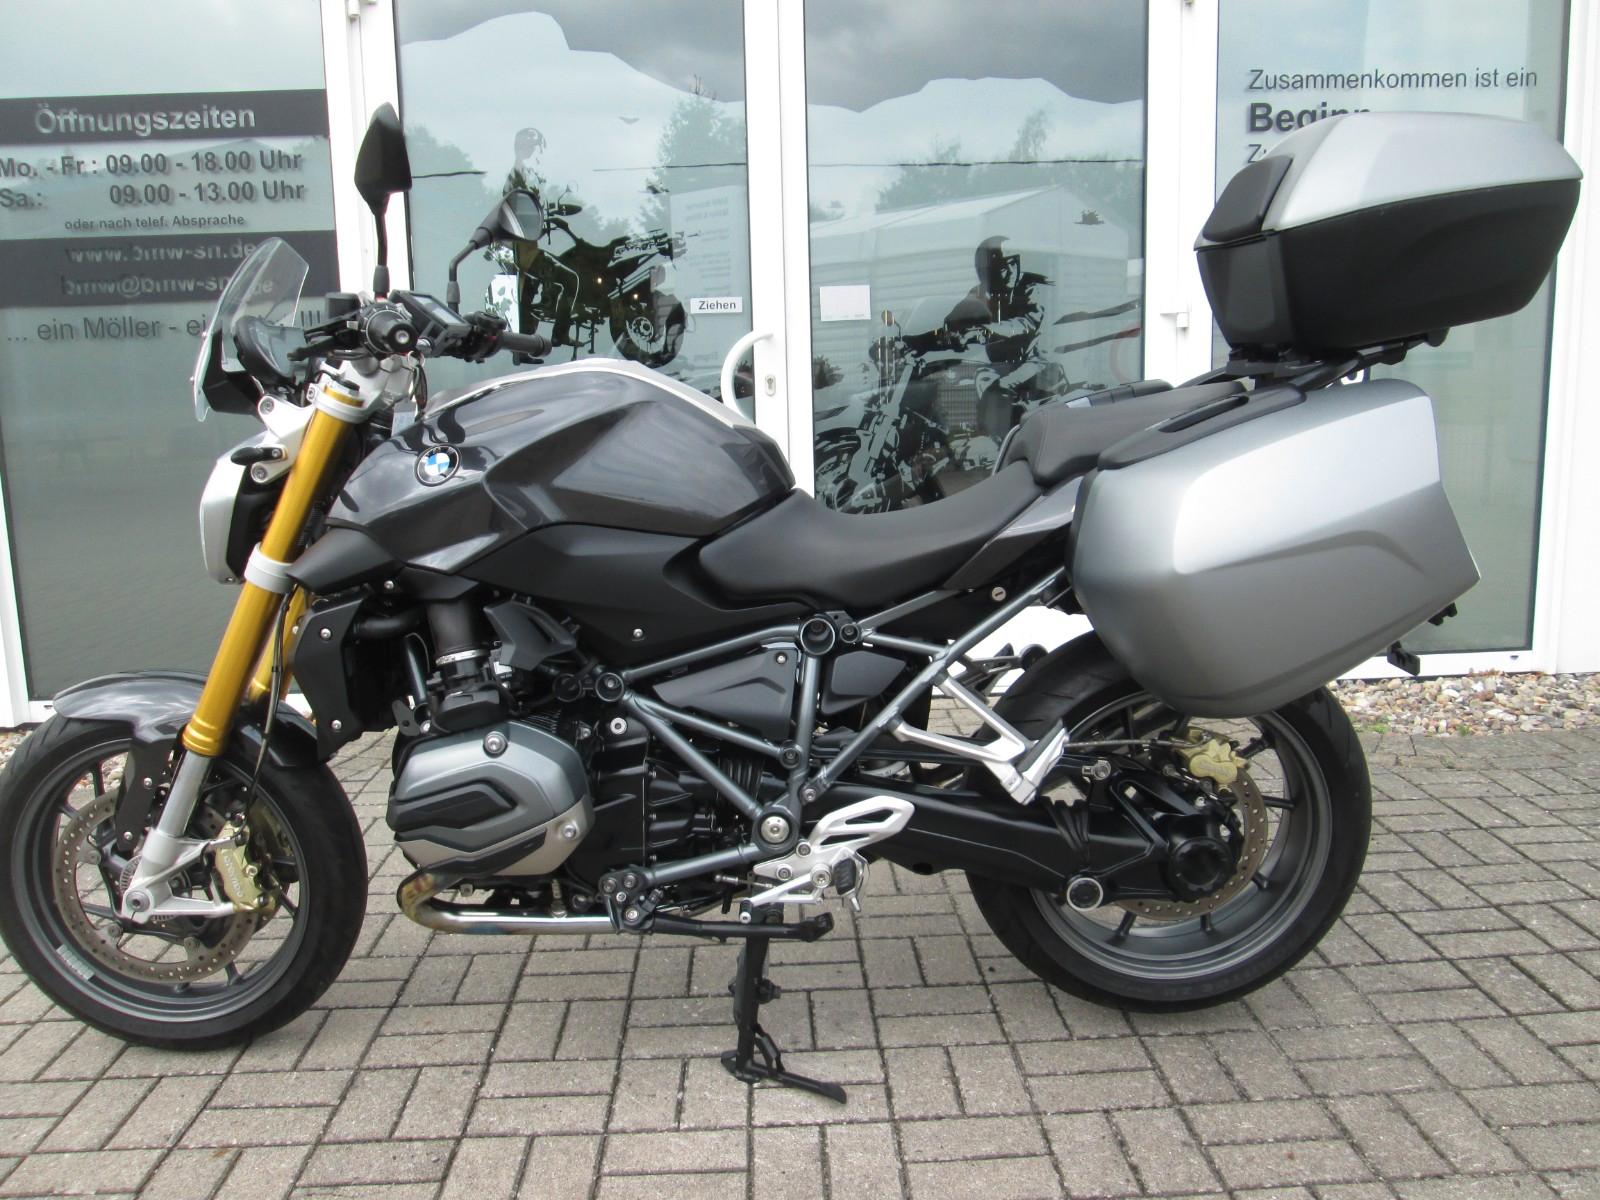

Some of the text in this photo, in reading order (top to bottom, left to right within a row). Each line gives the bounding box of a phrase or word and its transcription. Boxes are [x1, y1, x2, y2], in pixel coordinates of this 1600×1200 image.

[1248, 66, 1538, 91] Zusammenkommen ist ein
[34, 103, 256, 136] Öffnungszeiten
[1249, 101, 1371, 132] Begi
[0, 158, 38, 177] Mo.
[105, 153, 168, 174] 09.00
[191, 150, 252, 172] 18.00
[259, 149, 302, 170] Uhr
[109, 184, 171, 205] 09.00
[193, 181, 255, 202] 13.00
[262, 180, 305, 200] Uhr
[64, 214, 245, 230] oder nach telef. Absprache
[698, 300, 736, 310] Ziehen
[37, 319, 74, 340] ein
[84, 314, 161, 340] Möller
